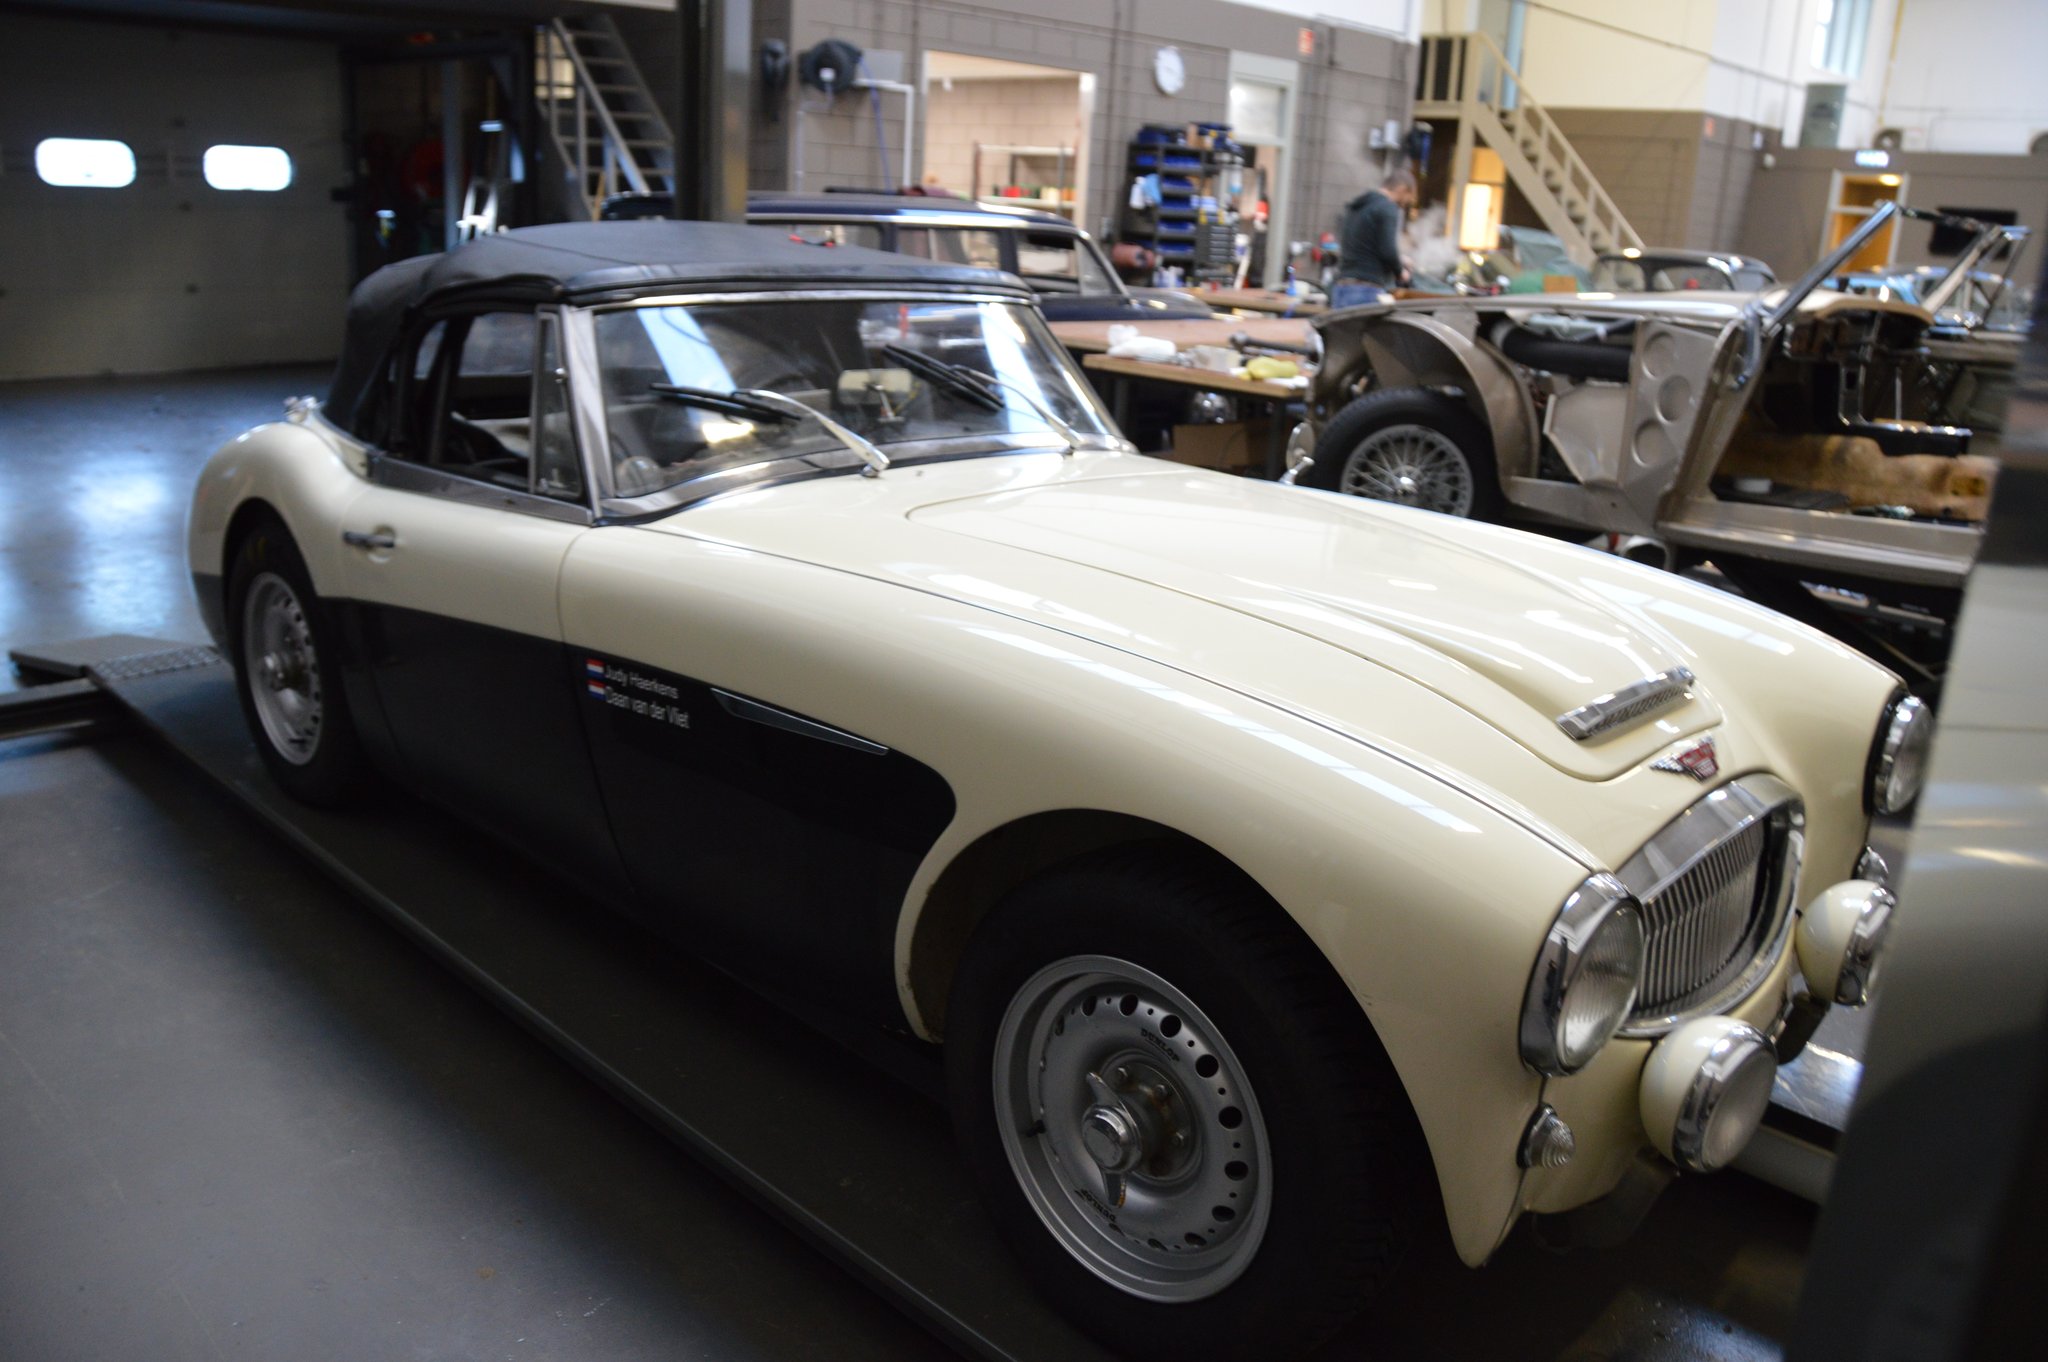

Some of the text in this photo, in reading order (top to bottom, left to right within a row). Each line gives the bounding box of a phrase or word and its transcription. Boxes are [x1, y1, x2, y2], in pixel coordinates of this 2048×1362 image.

[605, 664, 628, 686] Judy
[630, 698, 648, 715] van
[649, 701, 666, 720] der
[1140, 1028, 1180, 1062] DUNLOP
[1080, 1188, 1116, 1222] DUNLOP
